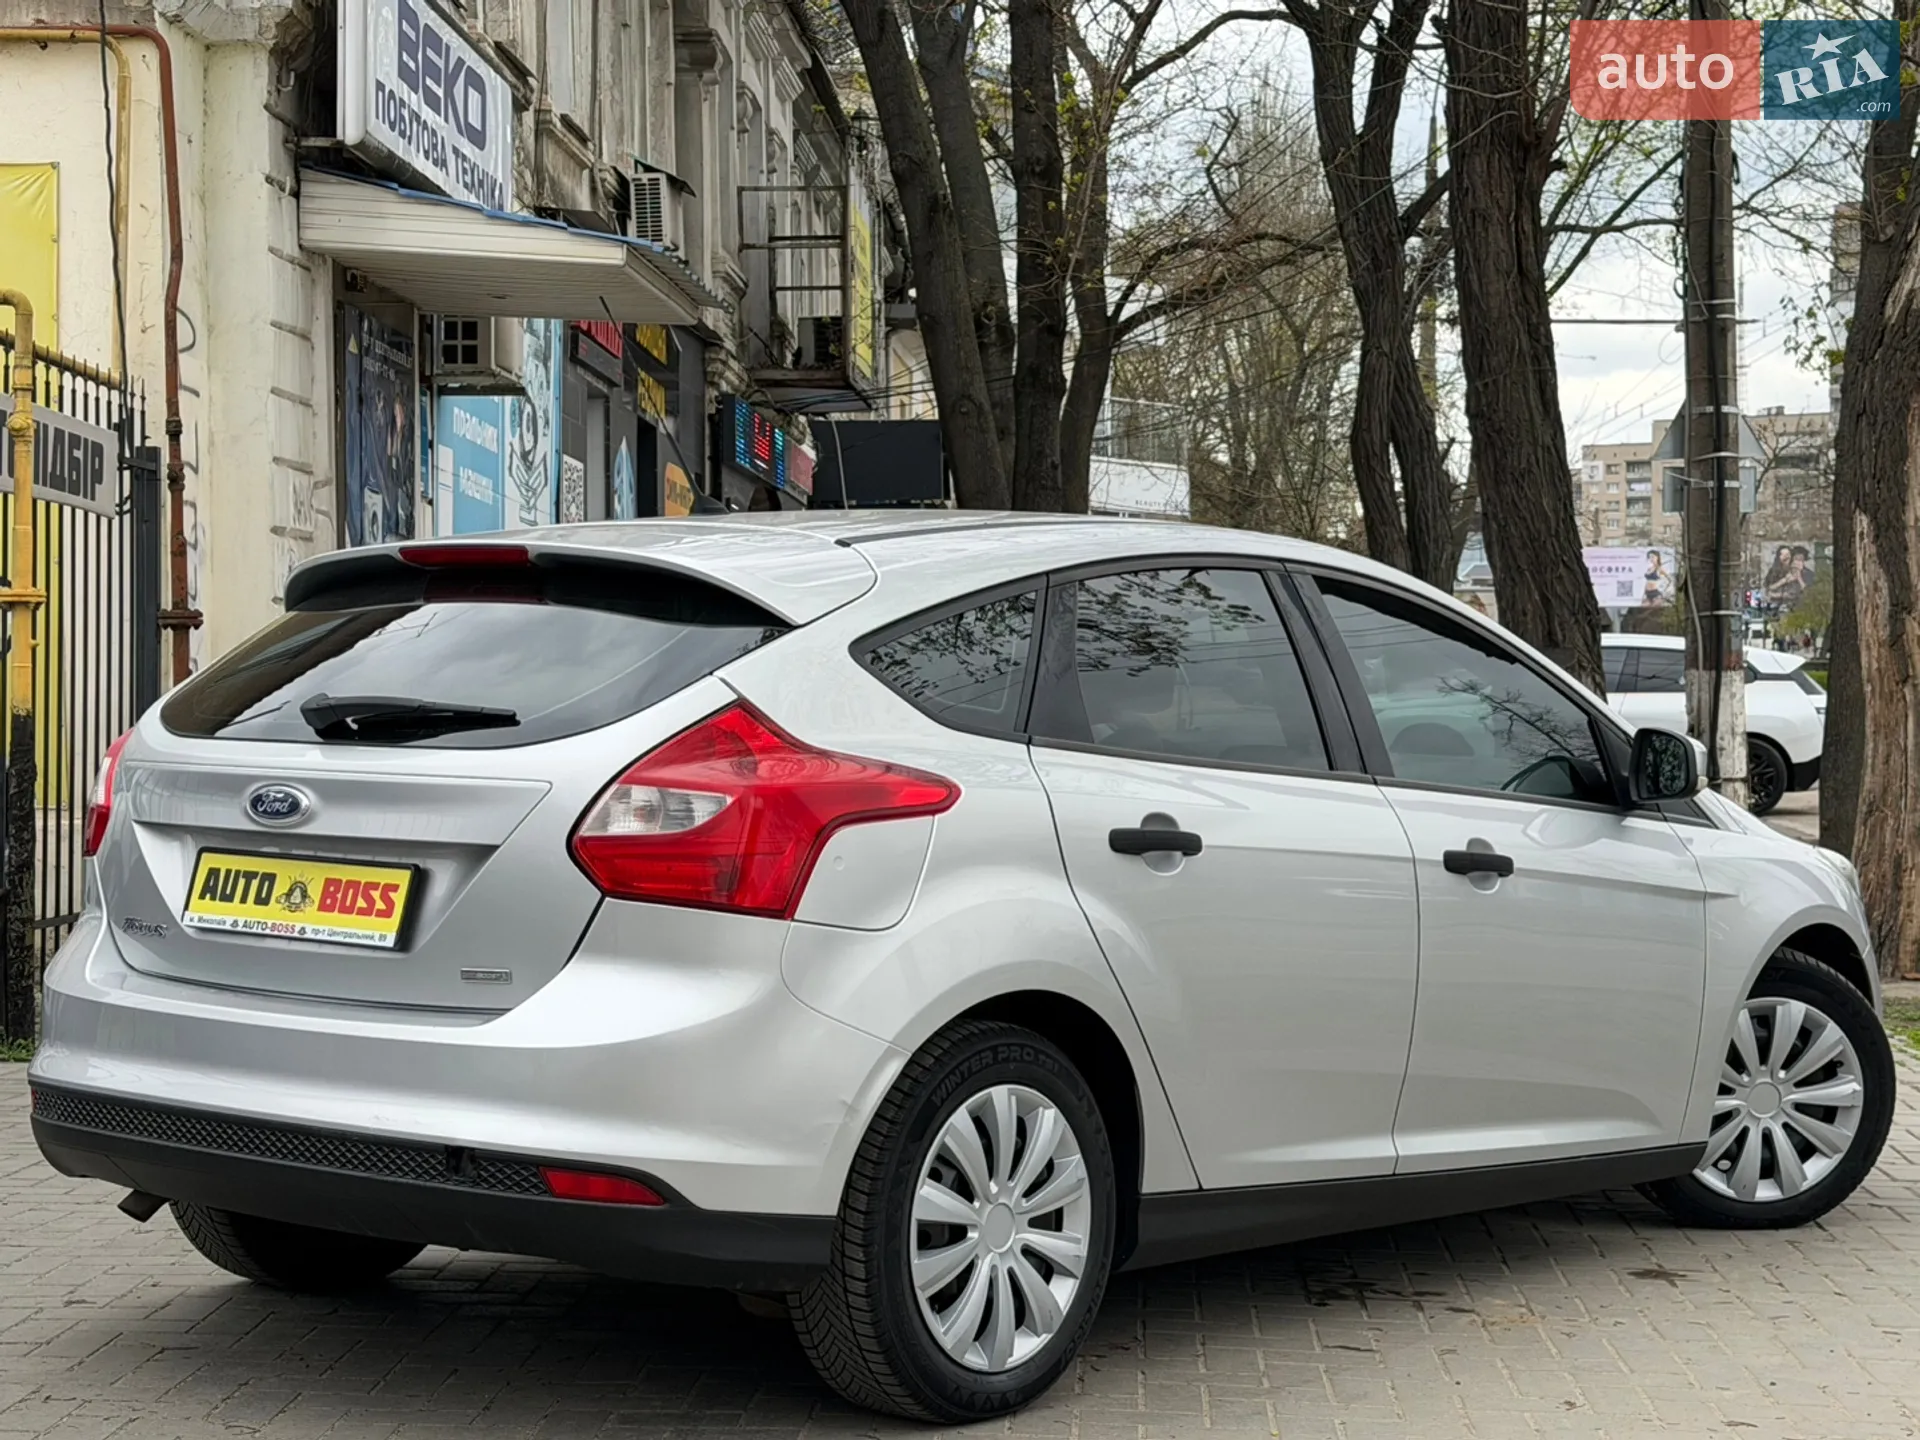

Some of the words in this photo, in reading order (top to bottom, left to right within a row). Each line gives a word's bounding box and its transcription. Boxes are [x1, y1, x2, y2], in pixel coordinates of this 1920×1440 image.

[398, 0, 487, 152] BEKO
[375, 78, 449, 177] ПОБУТОВА
[452, 144, 504, 212] ТЕХНІКА
[257, 789, 292, 813] Ford
[198, 867, 277, 906] AUTO
[316, 877, 400, 919] BOSS
[241, 919, 296, 934] AUTO-BOSS
[931, 1049, 994, 1106] WINTER
[997, 1045, 1035, 1061] PRO
